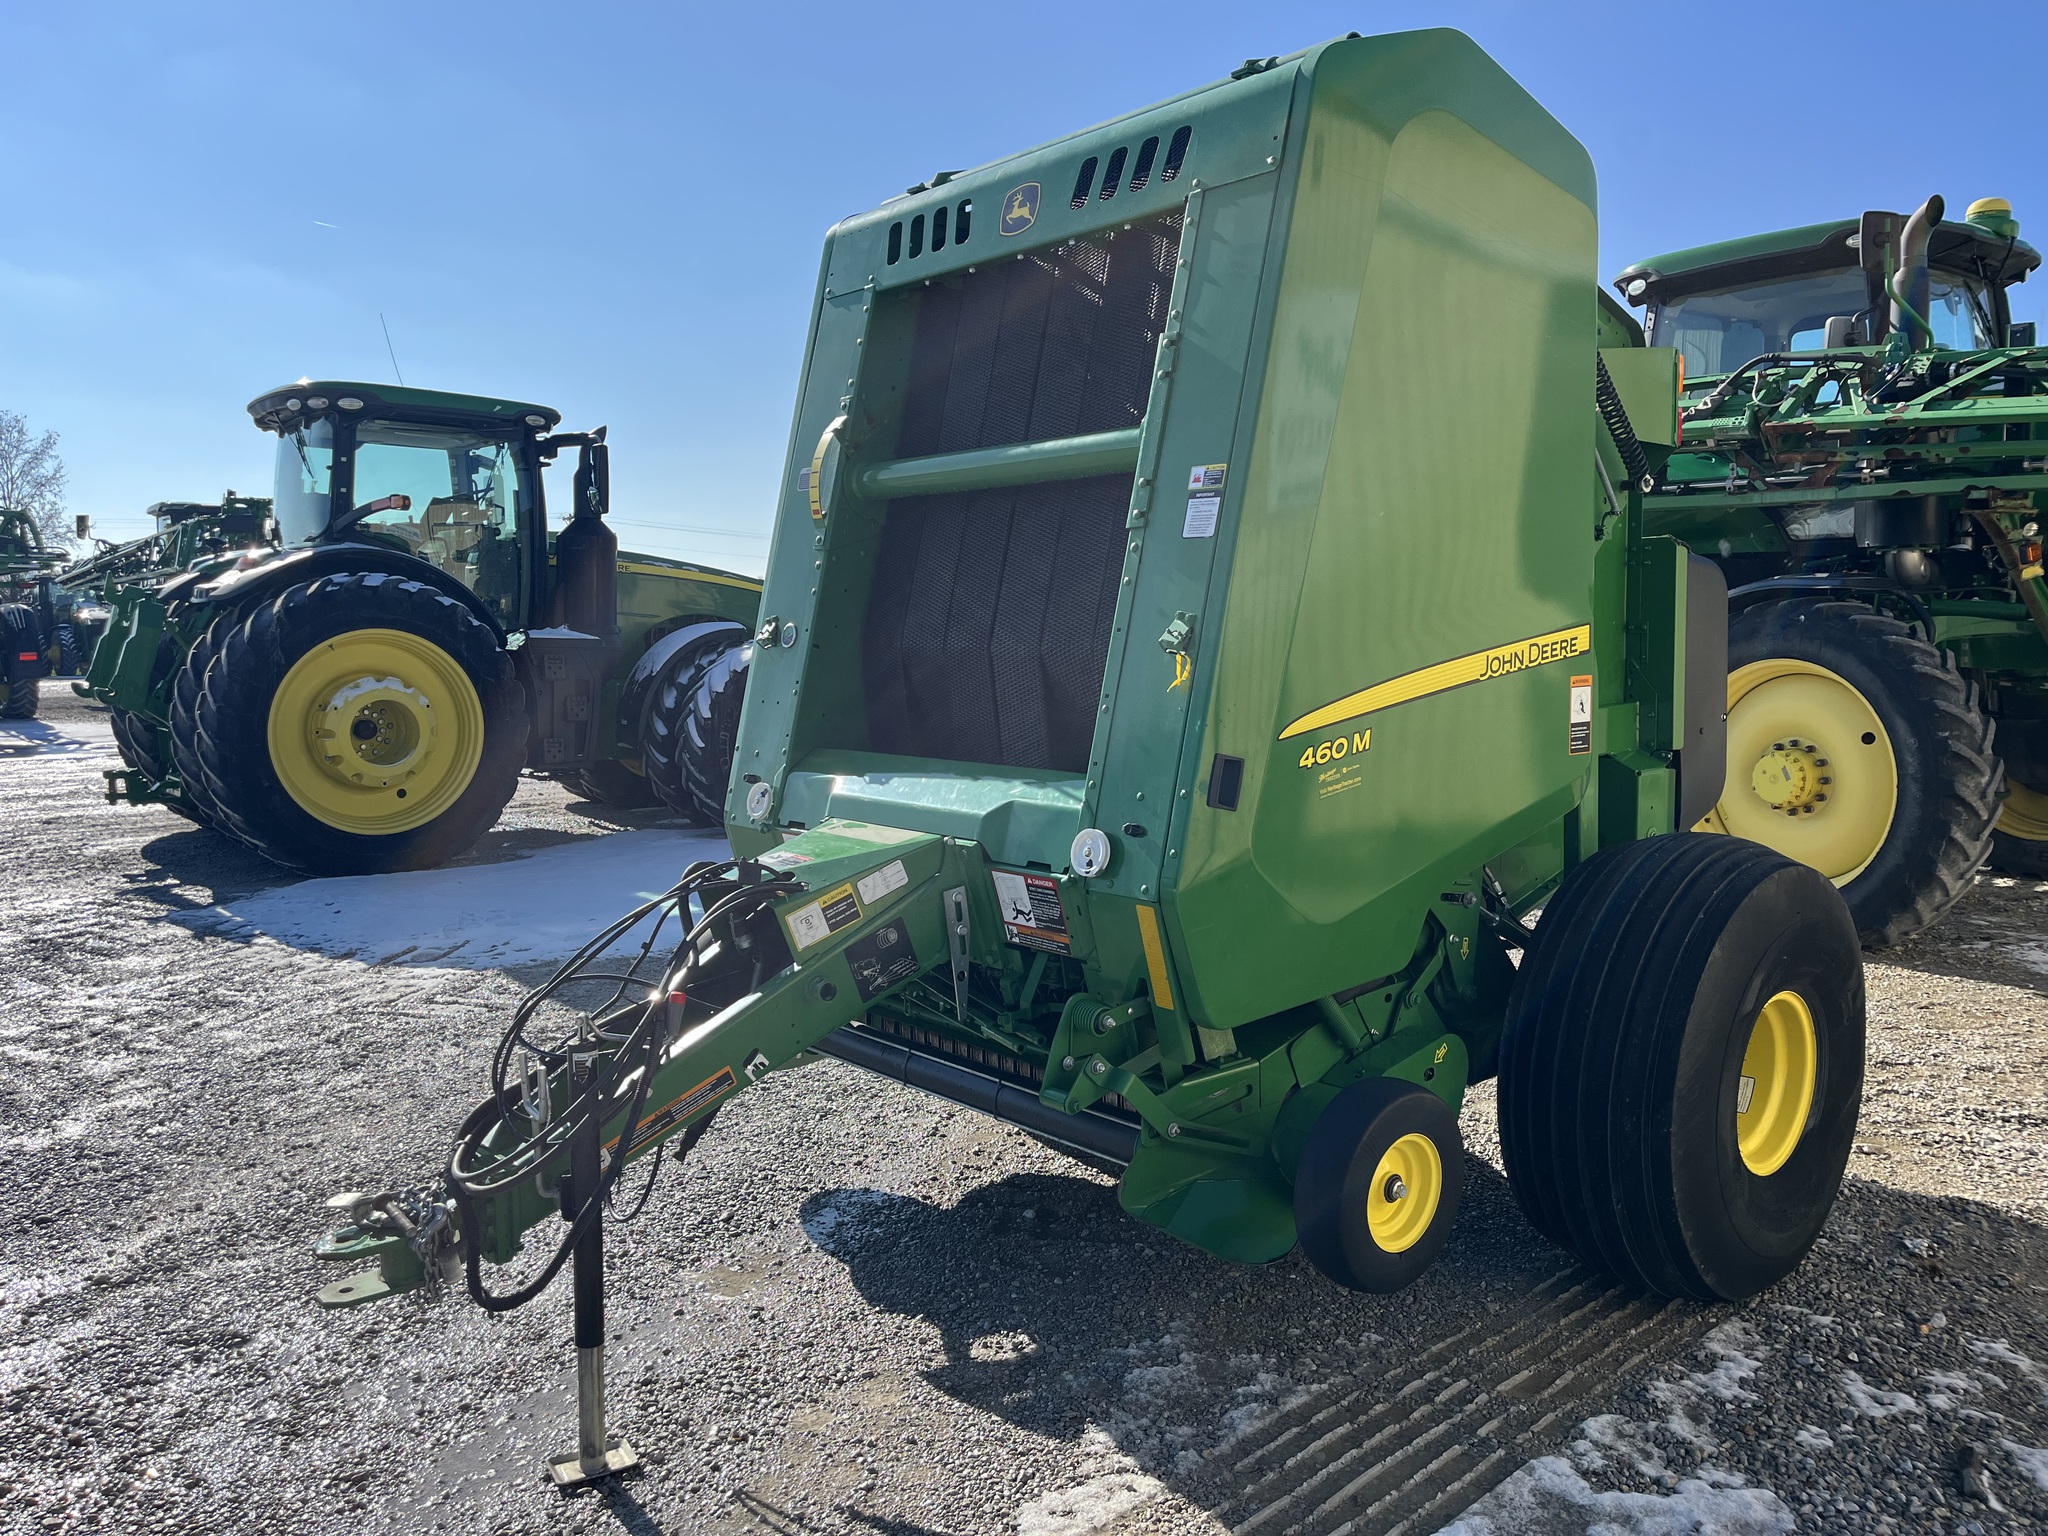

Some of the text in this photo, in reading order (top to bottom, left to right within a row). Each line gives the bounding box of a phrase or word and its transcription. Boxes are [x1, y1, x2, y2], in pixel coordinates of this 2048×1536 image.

[1480, 636, 1578, 678] JOHN DEERE
[1298, 728, 1372, 769] 460 M
[827, 888, 848, 902] CAUTION
[1032, 879, 1053, 887] DANGER
